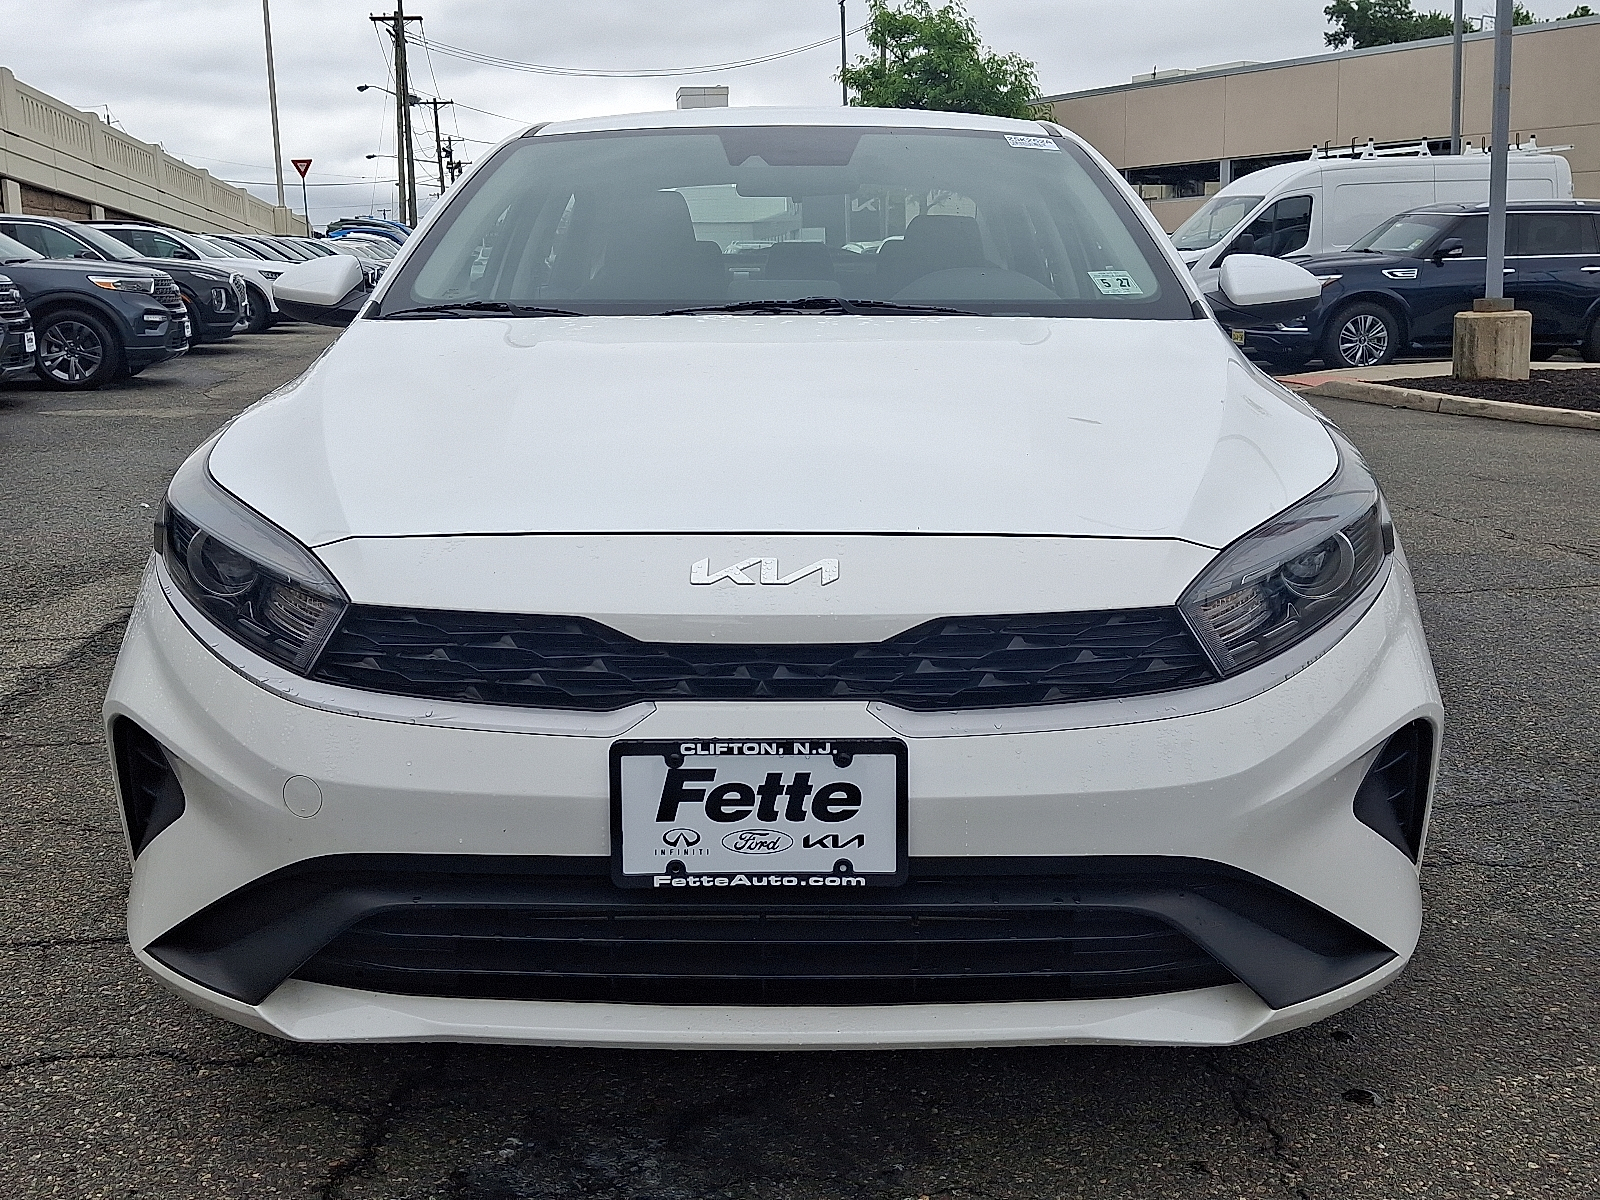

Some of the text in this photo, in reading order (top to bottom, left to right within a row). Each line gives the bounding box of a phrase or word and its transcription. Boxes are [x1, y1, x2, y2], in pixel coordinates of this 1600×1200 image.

[1100, 277, 1131, 288] 5 27
[690, 557, 839, 586] KIA
[680, 743, 838, 755] CLIFTON, N.J.
[655, 768, 862, 823] Fette
[733, 832, 781, 851] Ford
[802, 834, 865, 849] KIA
[654, 848, 710, 856] INFINITI
[653, 875, 866, 887] FetteAuto.com
